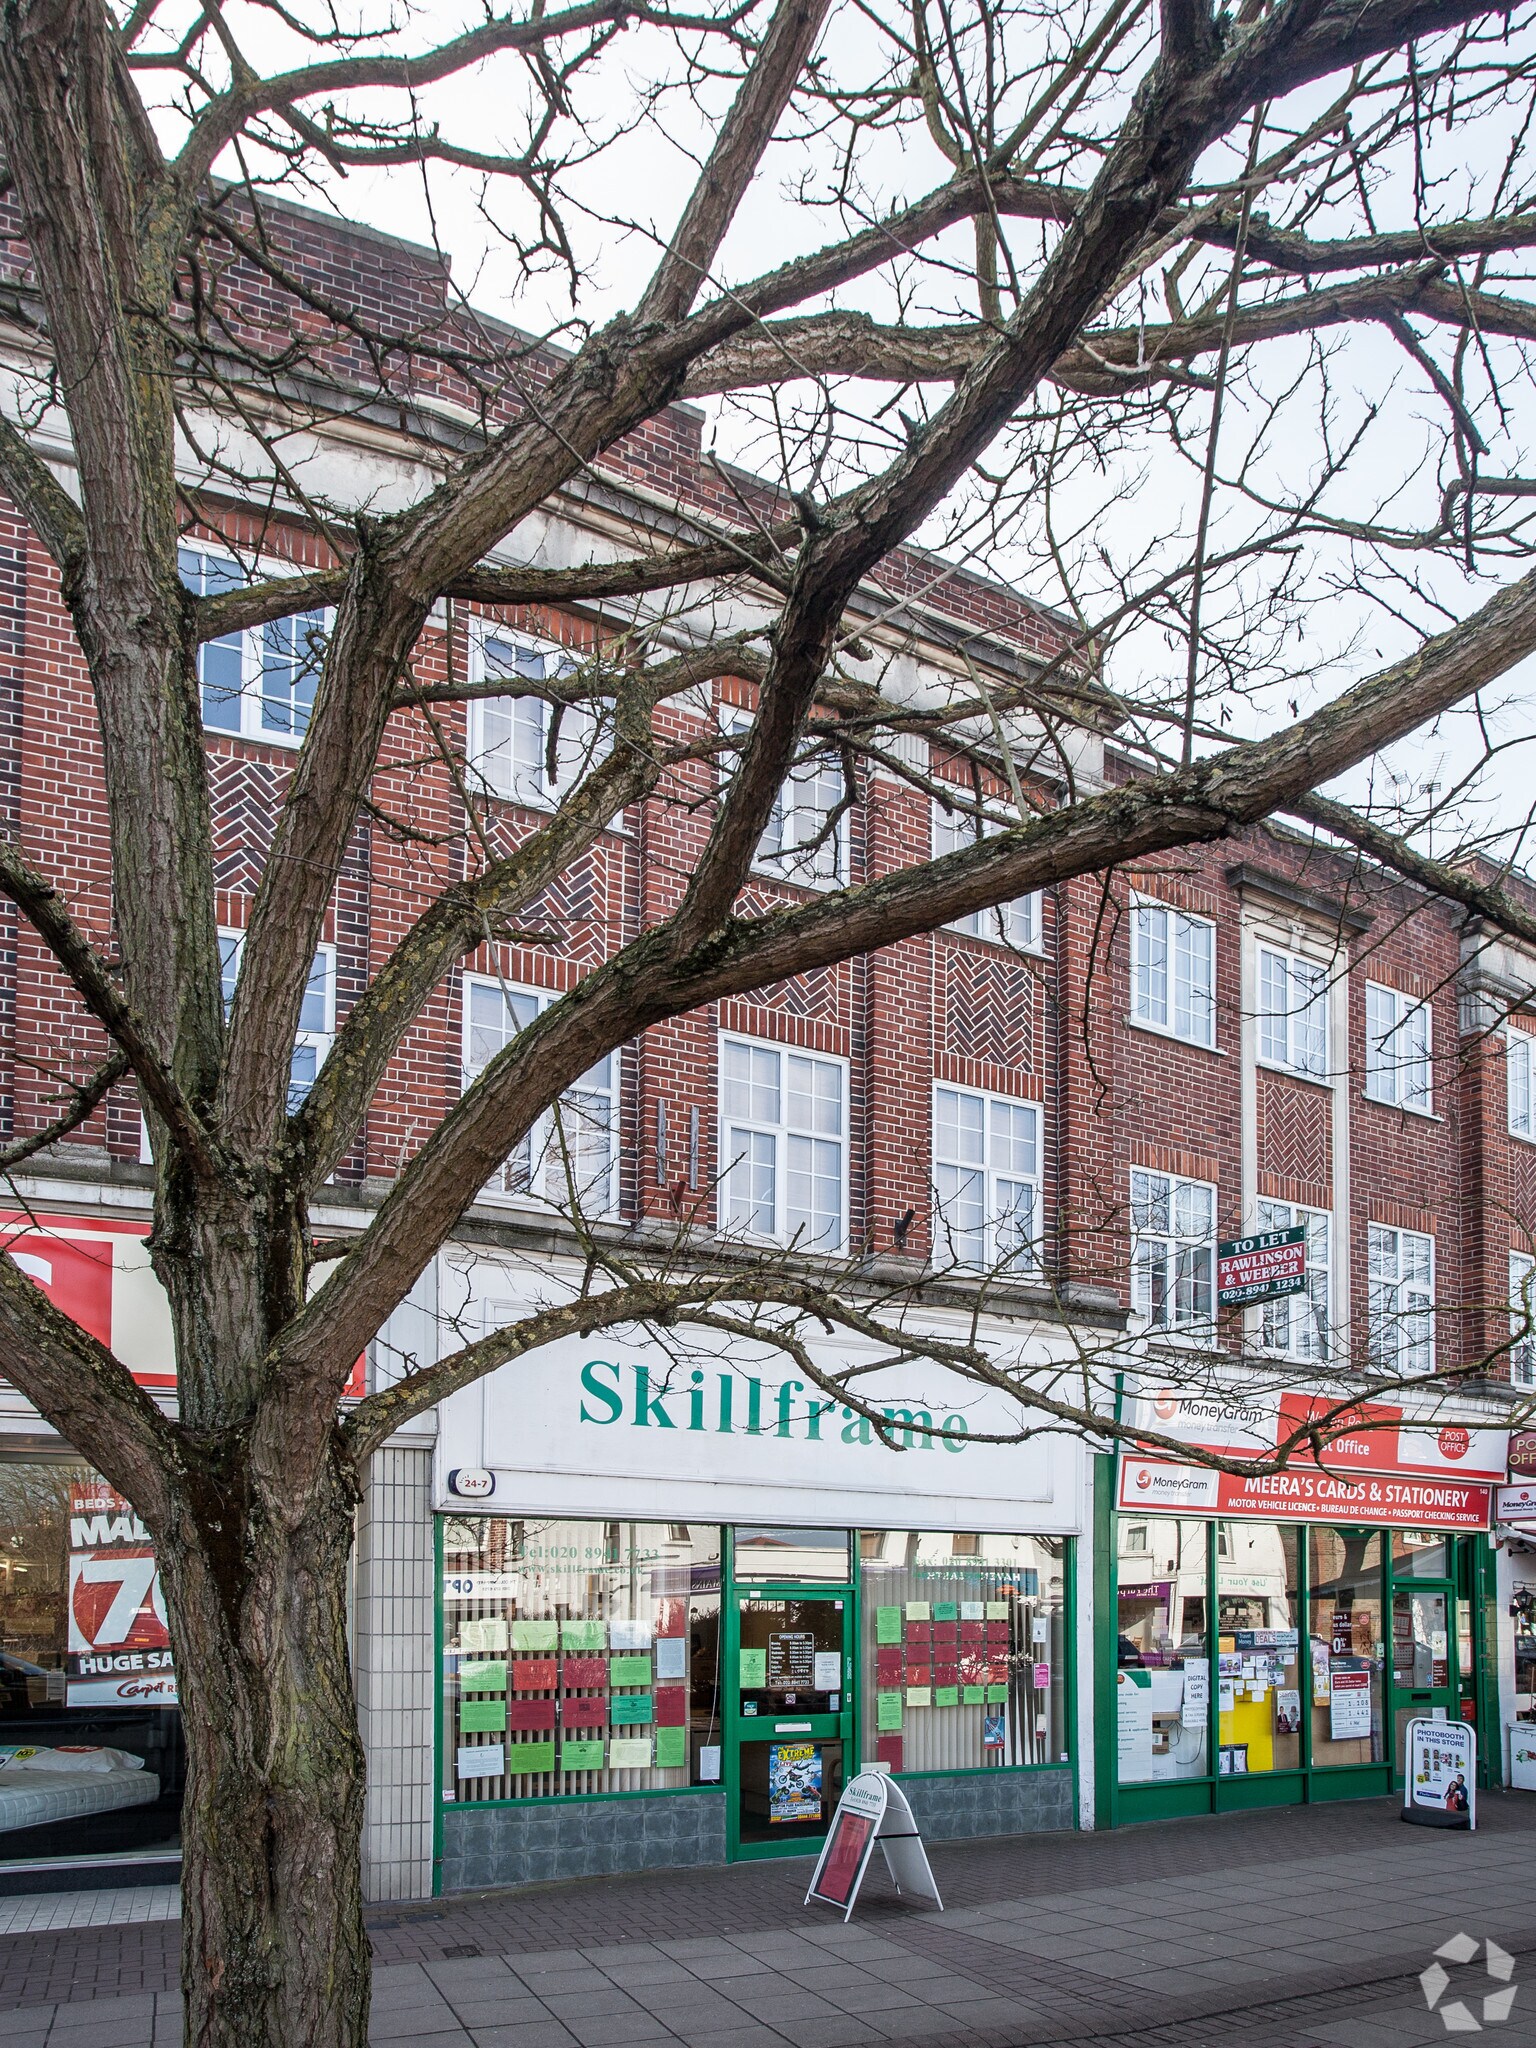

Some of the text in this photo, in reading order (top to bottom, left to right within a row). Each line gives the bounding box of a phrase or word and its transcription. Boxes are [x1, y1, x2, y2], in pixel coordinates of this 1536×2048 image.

[1232, 1231, 1289, 1254] TO LET
[1220, 1246, 1303, 1274] RAWLINSON
[1224, 1274, 1236, 1286] &
[1275, 1277, 1301, 1290] 1234
[579, 1360, 969, 1454] Skillframe
[1179, 1399, 1262, 1422] MoneyGram
[1177, 1421, 1238, 1434] money transfer
[1444, 1431, 1465, 1442] POST
[1336, 1439, 1370, 1456] Office
[1440, 1441, 1466, 1453] OFFICE
[464, 1479, 488, 1488] 24-7
[1152, 1476, 1208, 1490] MoneyGram
[1316, 1480, 1365, 1501] CARDS
[1369, 1482, 1382, 1502] &
[1385, 1485, 1470, 1508] STATIONERY
[74, 1498, 115, 1510] BEDS
[1228, 1498, 1480, 1522] MOTOR VEHICLE LICENCE BUREAU DE CHANGE PASSPORT CHECKING SERVICE
[518, 1545, 578, 1559] Tel:020
[624, 1548, 660, 1560] 7733
[1255, 1635, 1276, 1644] DEALS
[79, 1654, 144, 1675] HUGE
[116, 1679, 165, 1699] Carpet
[1416, 1729, 1465, 1740] PHOTOBOOTH
[1425, 1736, 1440, 1744] THIS
[1441, 1739, 1465, 1748] STORE
[777, 1746, 815, 1761] EXTREME
[849, 1787, 882, 1803] Skillframe
